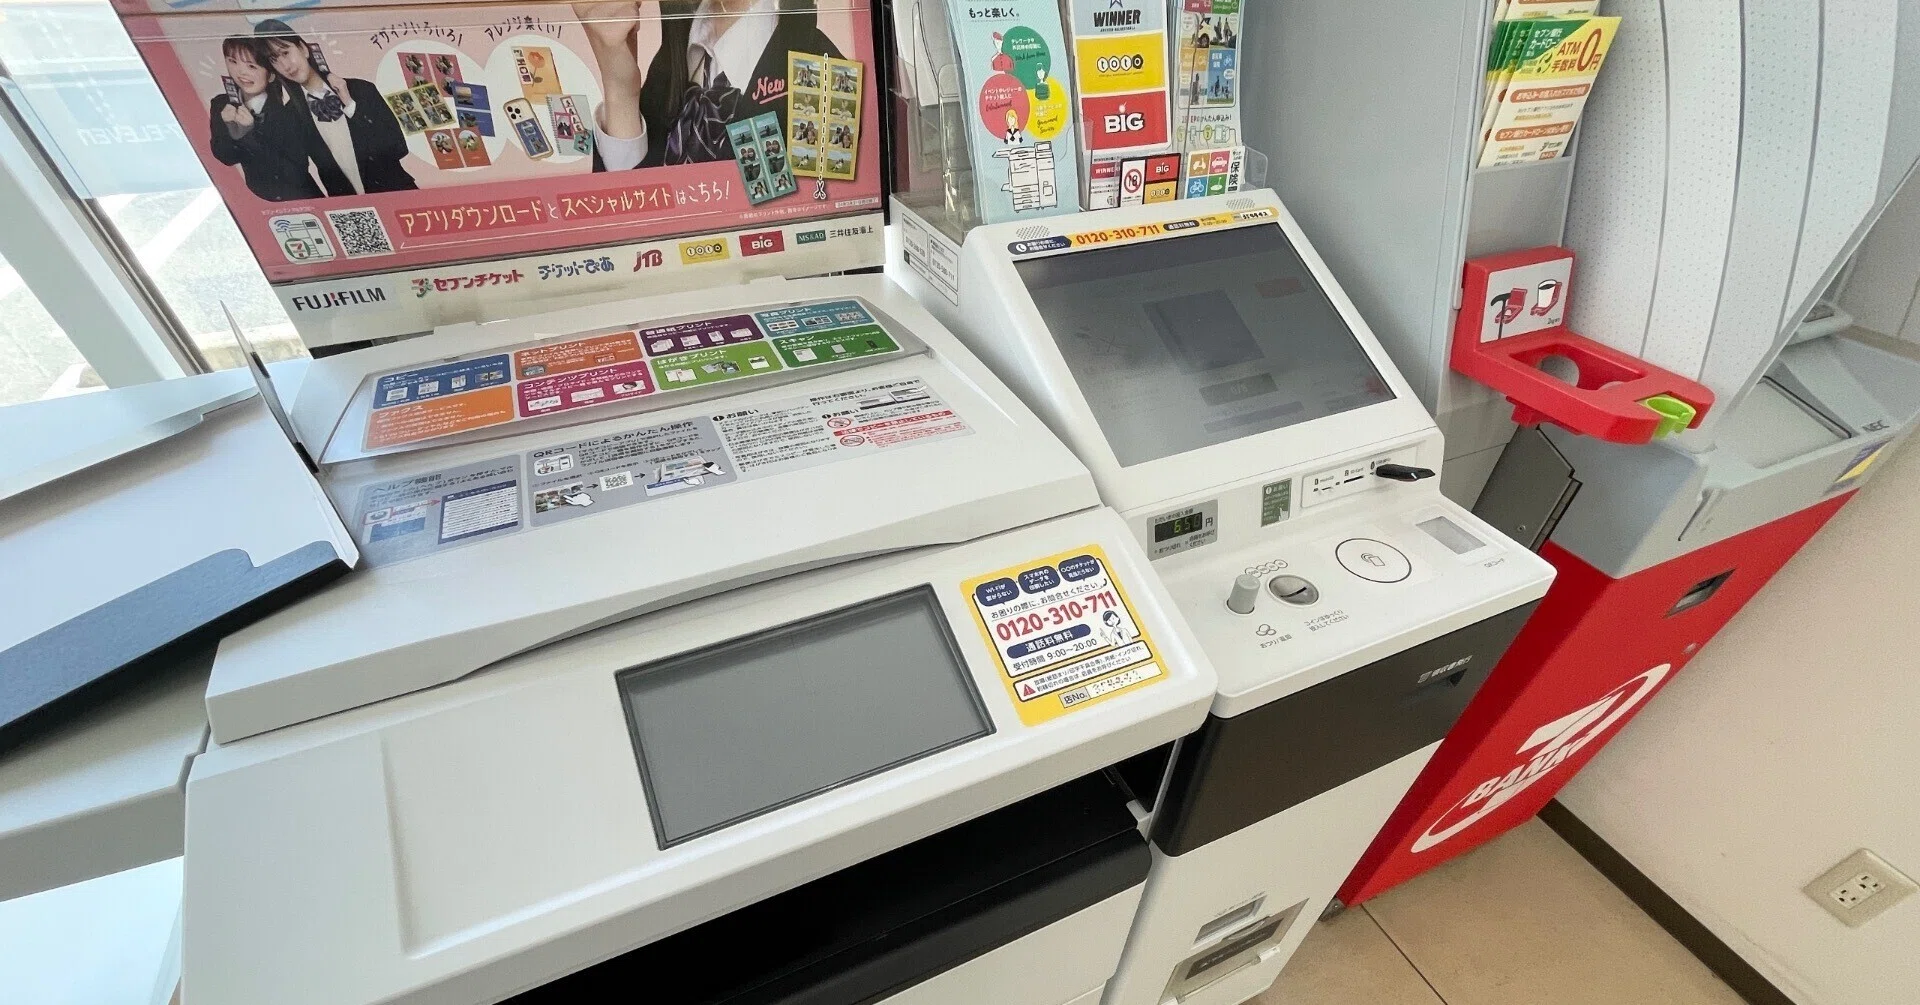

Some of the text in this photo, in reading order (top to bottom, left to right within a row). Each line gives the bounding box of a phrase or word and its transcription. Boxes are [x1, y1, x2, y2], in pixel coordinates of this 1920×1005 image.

[968, 7, 1020, 18] もっと楽しく。
[1093, 9, 1141, 27] WINNER
[1556, 41, 1582, 56] ATM
[1097, 54, 1144, 73] toto
[1551, 59, 1577, 73] 手数料
[751, 76, 787, 101] New
[1103, 104, 1145, 134] BIG
[1155, 163, 1170, 173] BIG
[1229, 161, 1241, 186] 保険
[829, 225, 874, 239] 三井住友海上
[1075, 224, 1160, 245] 0120-310-711
[686, 243, 723, 257] toto
[751, 235, 774, 250] BIG
[538, 256, 615, 281] チケットぴあ
[633, 249, 663, 273] JTB
[433, 269, 525, 292] セブンチケット
[292, 287, 386, 311] FUJIFILM
[779, 334, 816, 345] スキャン
[520, 342, 586, 357] ネットプリント
[656, 349, 727, 365] はがきプリント
[523, 368, 618, 389] コンテンツプリント
[726, 409, 759, 419] お願い
[533, 421, 694, 458] QRコードによるかんたん操作
[372, 473, 442, 492] ヘルプ機能
[1205, 517, 1213, 527] 円
[996, 590, 1118, 642] 0120-310-711
[1025, 630, 1074, 653] 通話料無料
[1013, 656, 1046, 672] 受付時間
[1461, 735, 1589, 809] BANK
